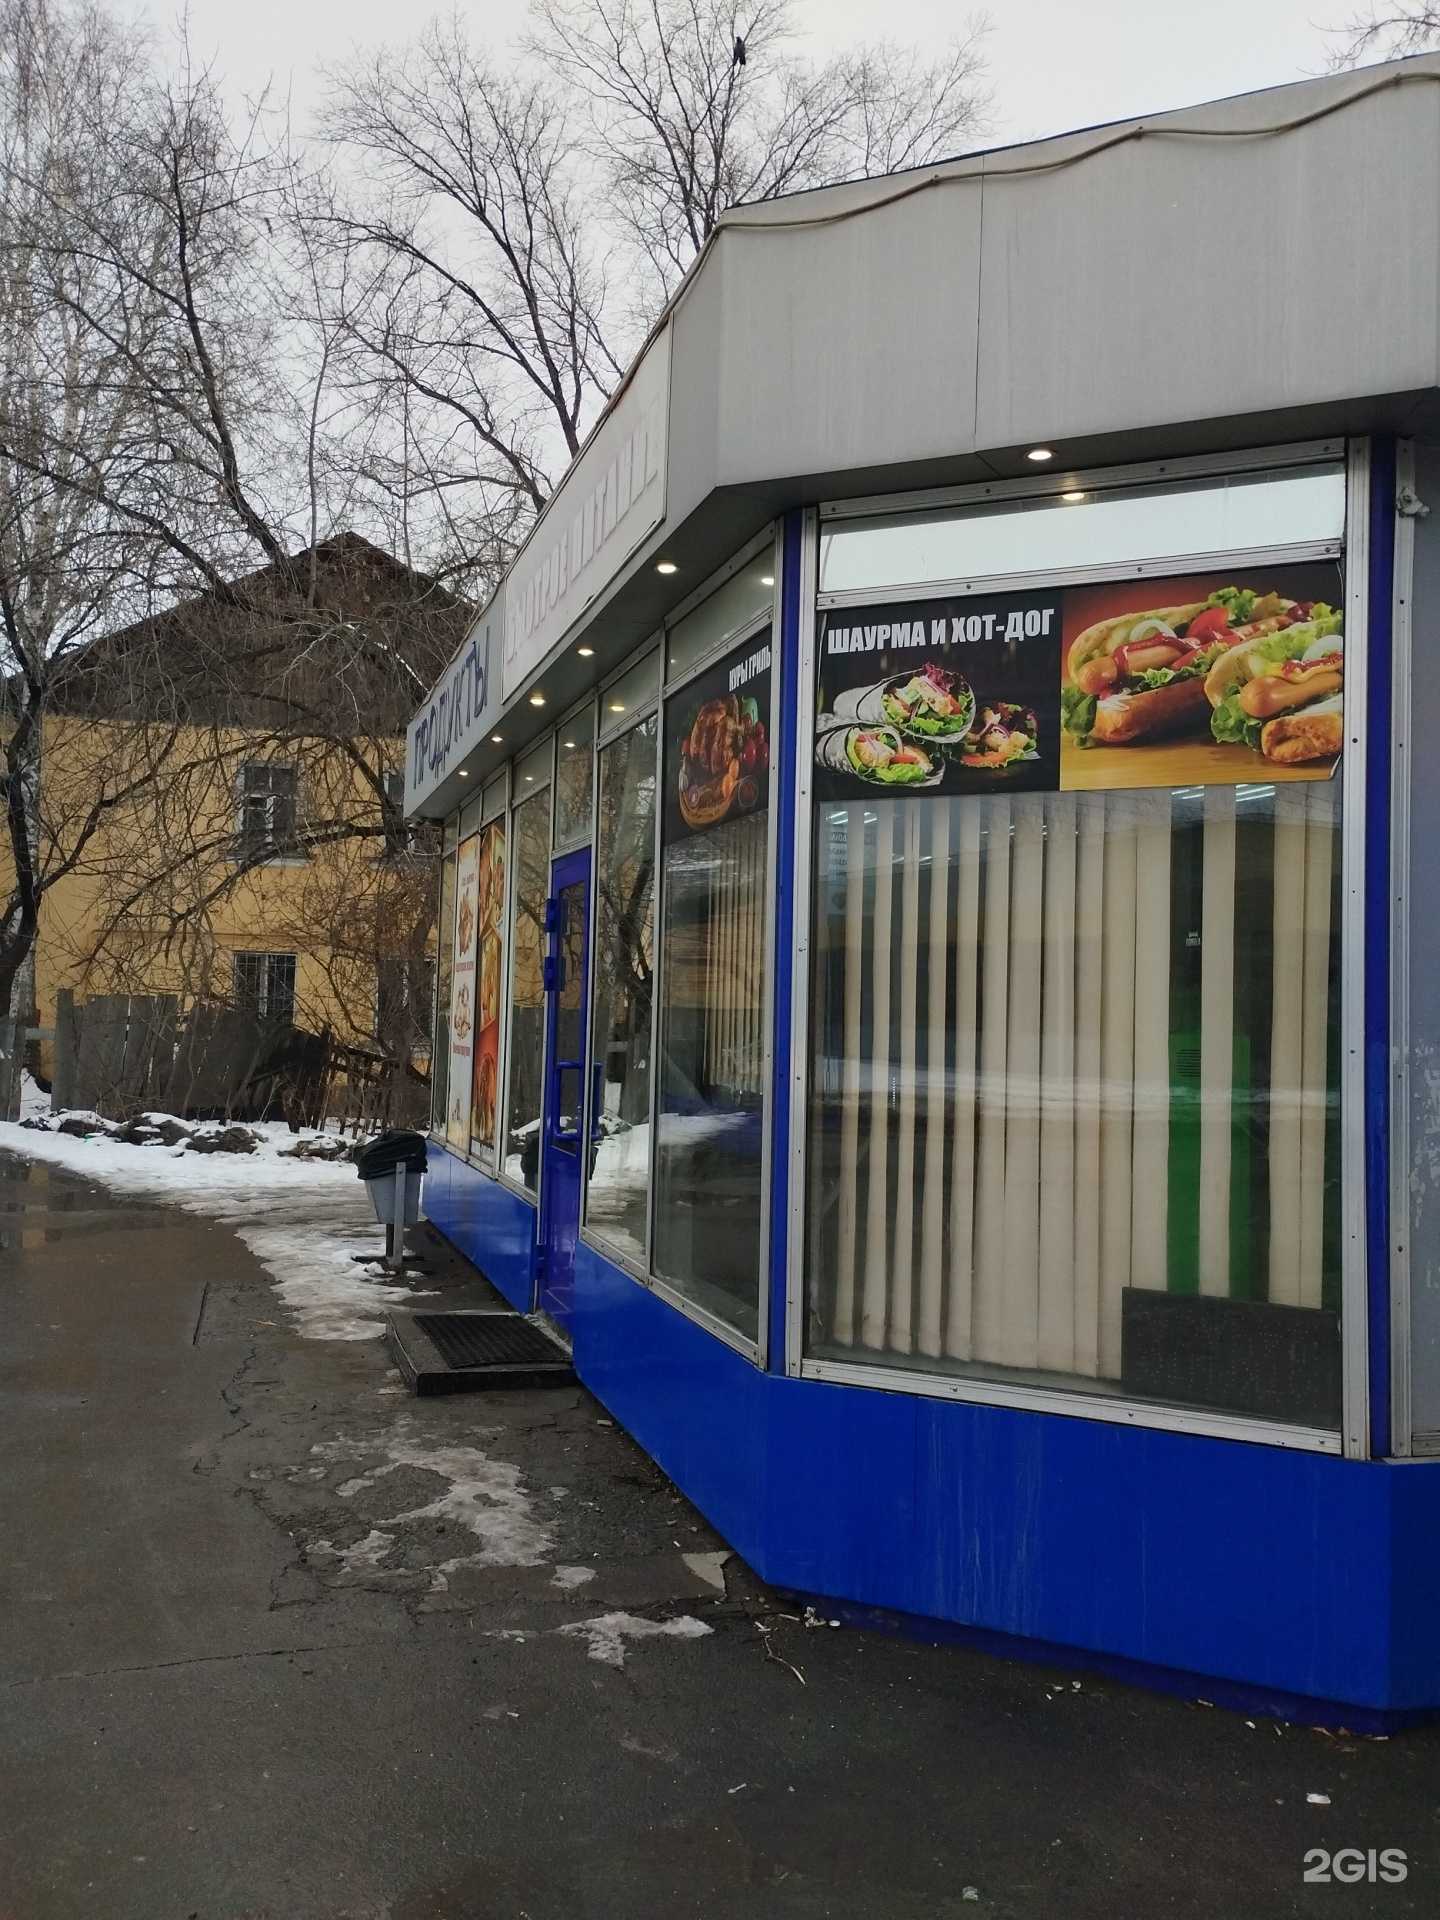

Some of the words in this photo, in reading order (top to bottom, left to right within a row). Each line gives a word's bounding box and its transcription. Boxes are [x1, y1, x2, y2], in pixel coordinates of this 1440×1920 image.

[828, 621, 926, 654] ШАУРМА
[931, 618, 946, 645] И
[951, 608, 1055, 643] ХОТ-ДОГ
[413, 625, 491, 790] ПРОДУКТЫ
